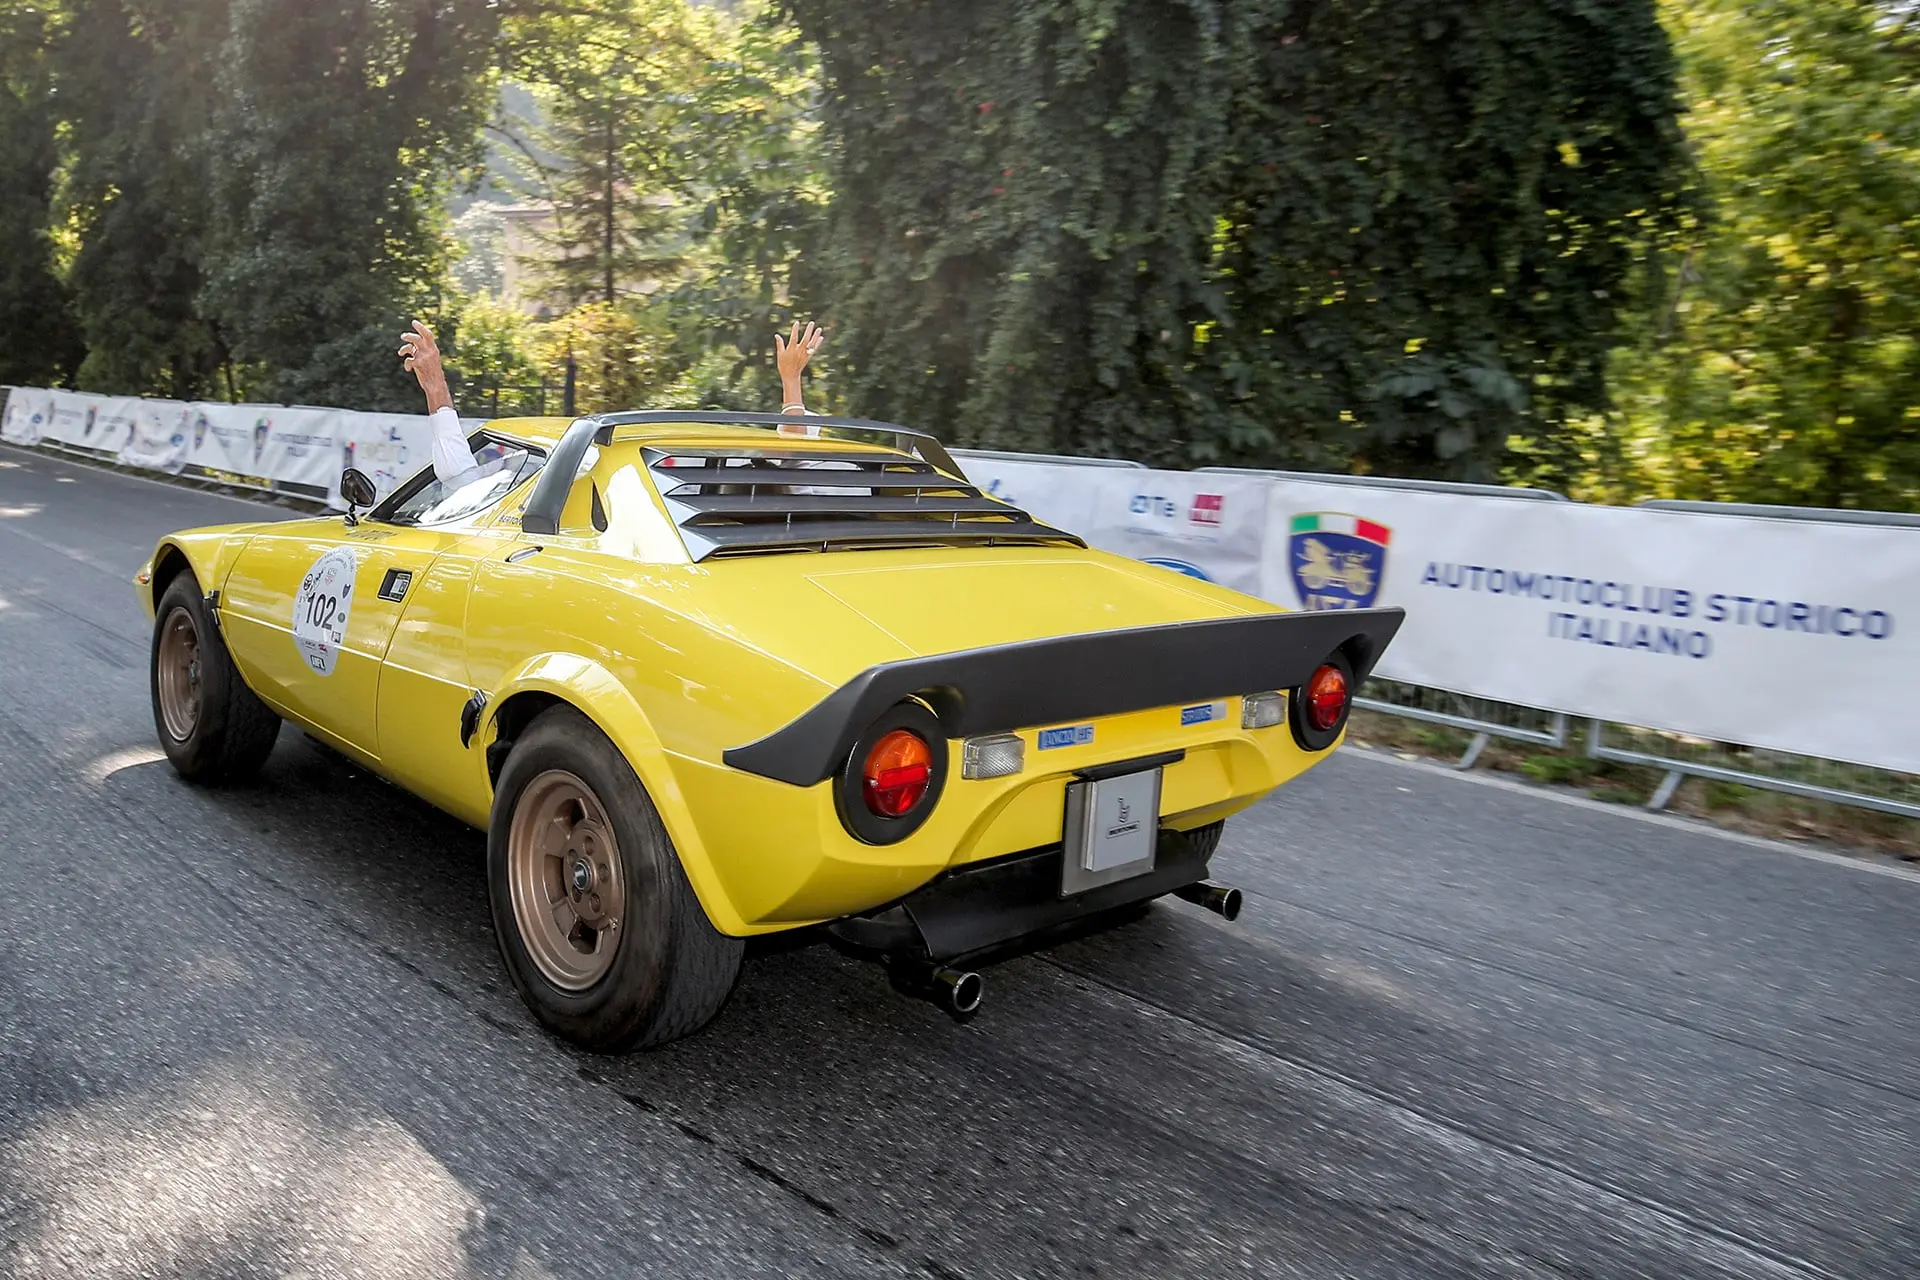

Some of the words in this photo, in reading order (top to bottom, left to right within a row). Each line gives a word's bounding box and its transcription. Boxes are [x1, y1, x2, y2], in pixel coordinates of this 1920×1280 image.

[306, 592, 337, 631] 102
[1421, 561, 1696, 618] AUTOMOTOCLUB
[1706, 593, 1894, 640] STORICO
[1548, 611, 1713, 659] ITALIANO
